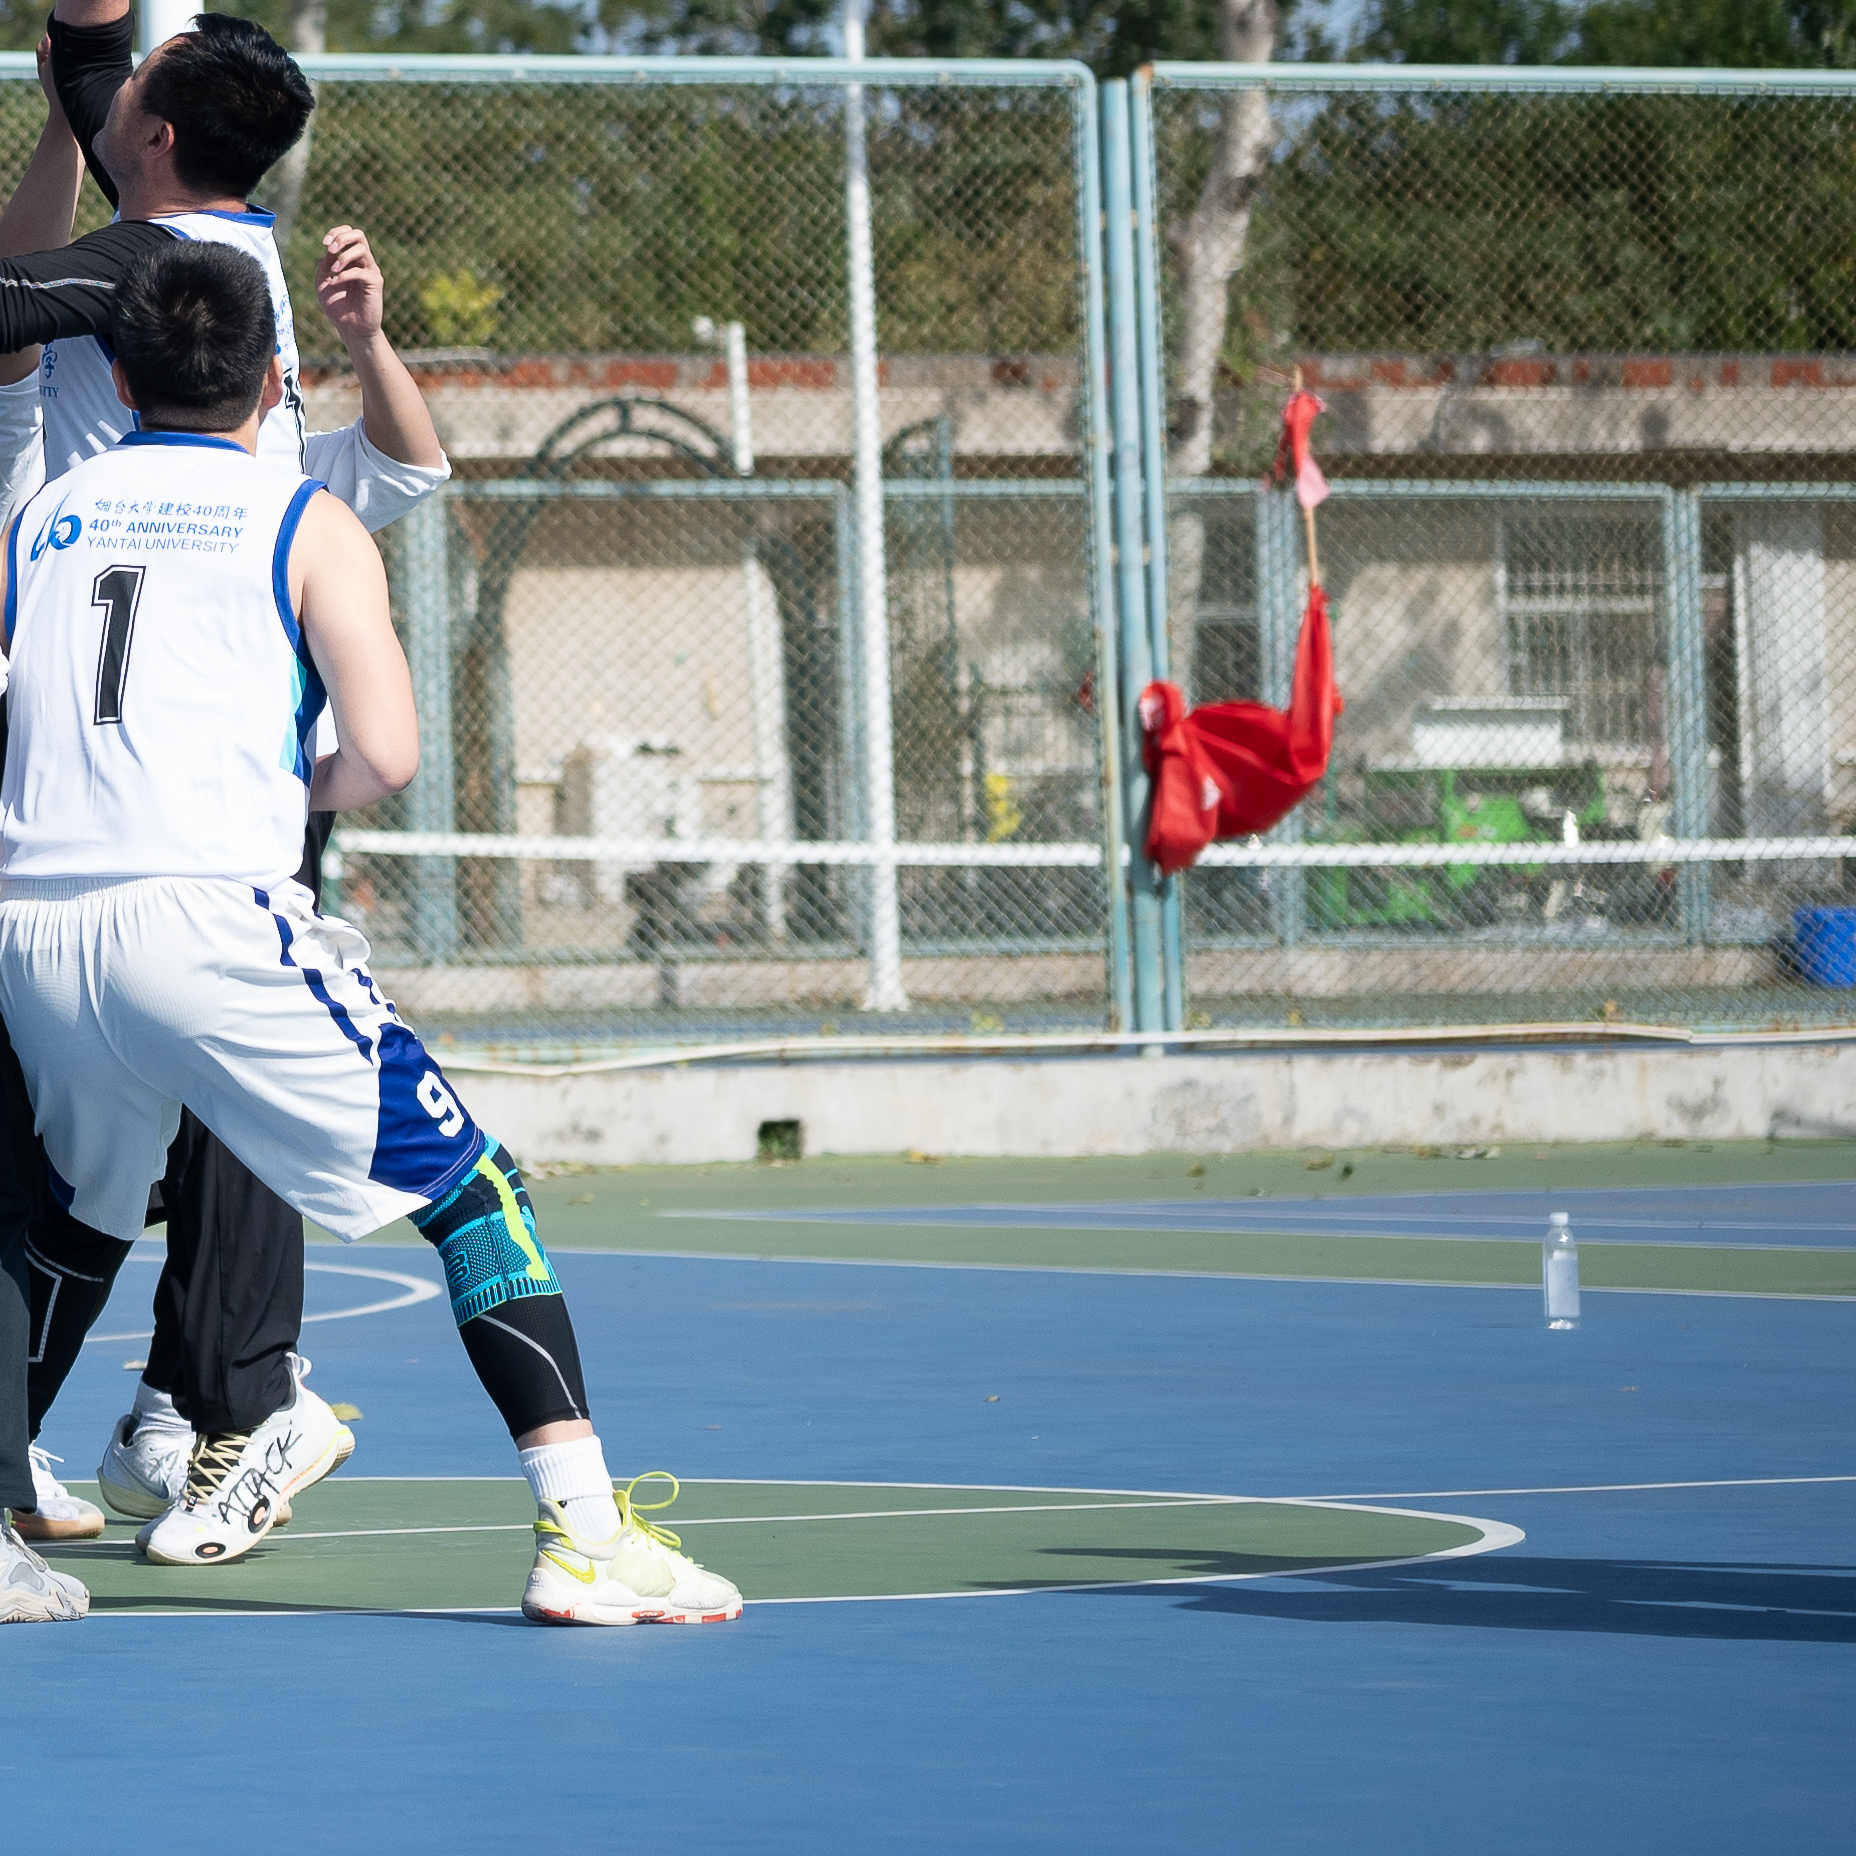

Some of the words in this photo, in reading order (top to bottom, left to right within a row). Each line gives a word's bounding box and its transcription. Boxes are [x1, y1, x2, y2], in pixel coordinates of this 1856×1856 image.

[89, 517, 122, 532] 40th
[126, 521, 244, 538] ANNIVERSARY
[87, 536, 141, 550] YANTAI
[145, 537, 239, 554] UNIVERSITY
[91, 565, 146, 725] 1
